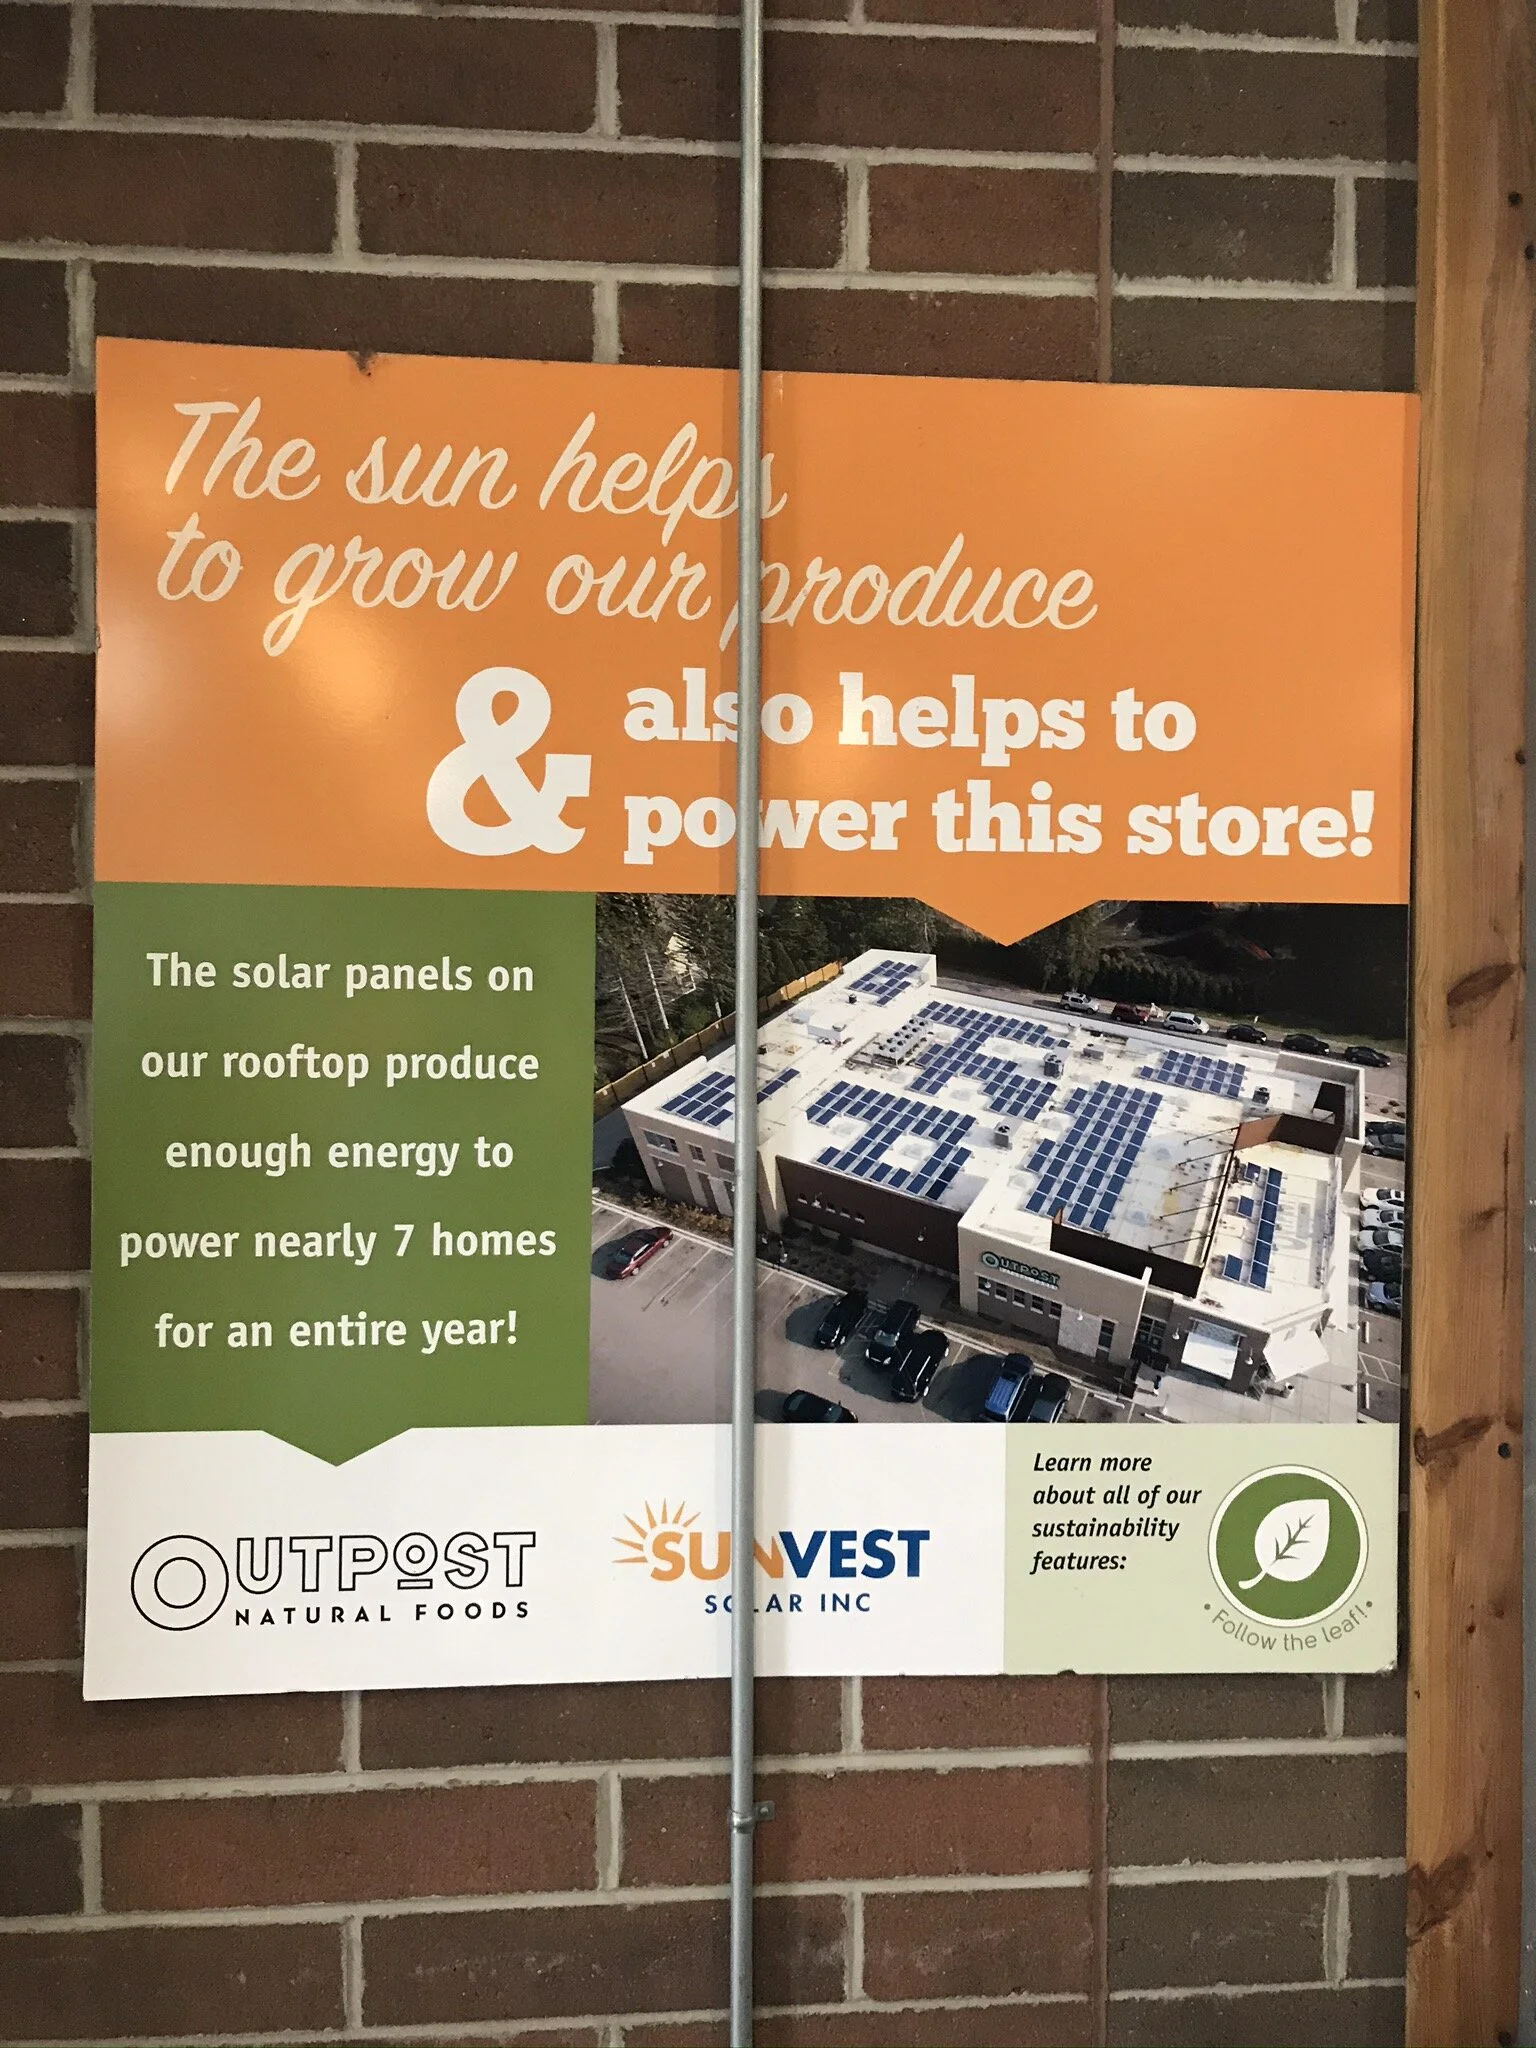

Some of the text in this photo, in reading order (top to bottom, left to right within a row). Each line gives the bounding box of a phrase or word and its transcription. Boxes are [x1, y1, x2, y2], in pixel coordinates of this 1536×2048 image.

[165, 397, 320, 500] The
[345, 436, 518, 510] sun
[157, 512, 243, 602] to
[263, 535, 518, 658] grow
[545, 551, 713, 622] our
[838, 671, 1087, 768] helps
[1110, 687, 1198, 753] to
[425, 665, 592, 857] &
[623, 779, 1376, 866] power this store!
[146, 952, 535, 998] The solar panels on
[140, 1043, 540, 1088] our rooftop produce
[165, 1133, 515, 1178] enough energy to
[119, 1221, 558, 1267] power nearly 7 homes
[155, 1310, 519, 1355] for an entire year!
[1033, 1452, 1153, 1472] Learn more
[1032, 1484, 1203, 1510] about all of our
[1031, 1517, 1180, 1541] sustainability
[130, 1530, 536, 1631] OUTPOST
[1029, 1550, 1127, 1576] features:
[235, 1601, 530, 1627] NATURAL FOODS
[820, 1592, 871, 1613] INC
[1211, 1604, 1368, 1652] Follow the leaf!
